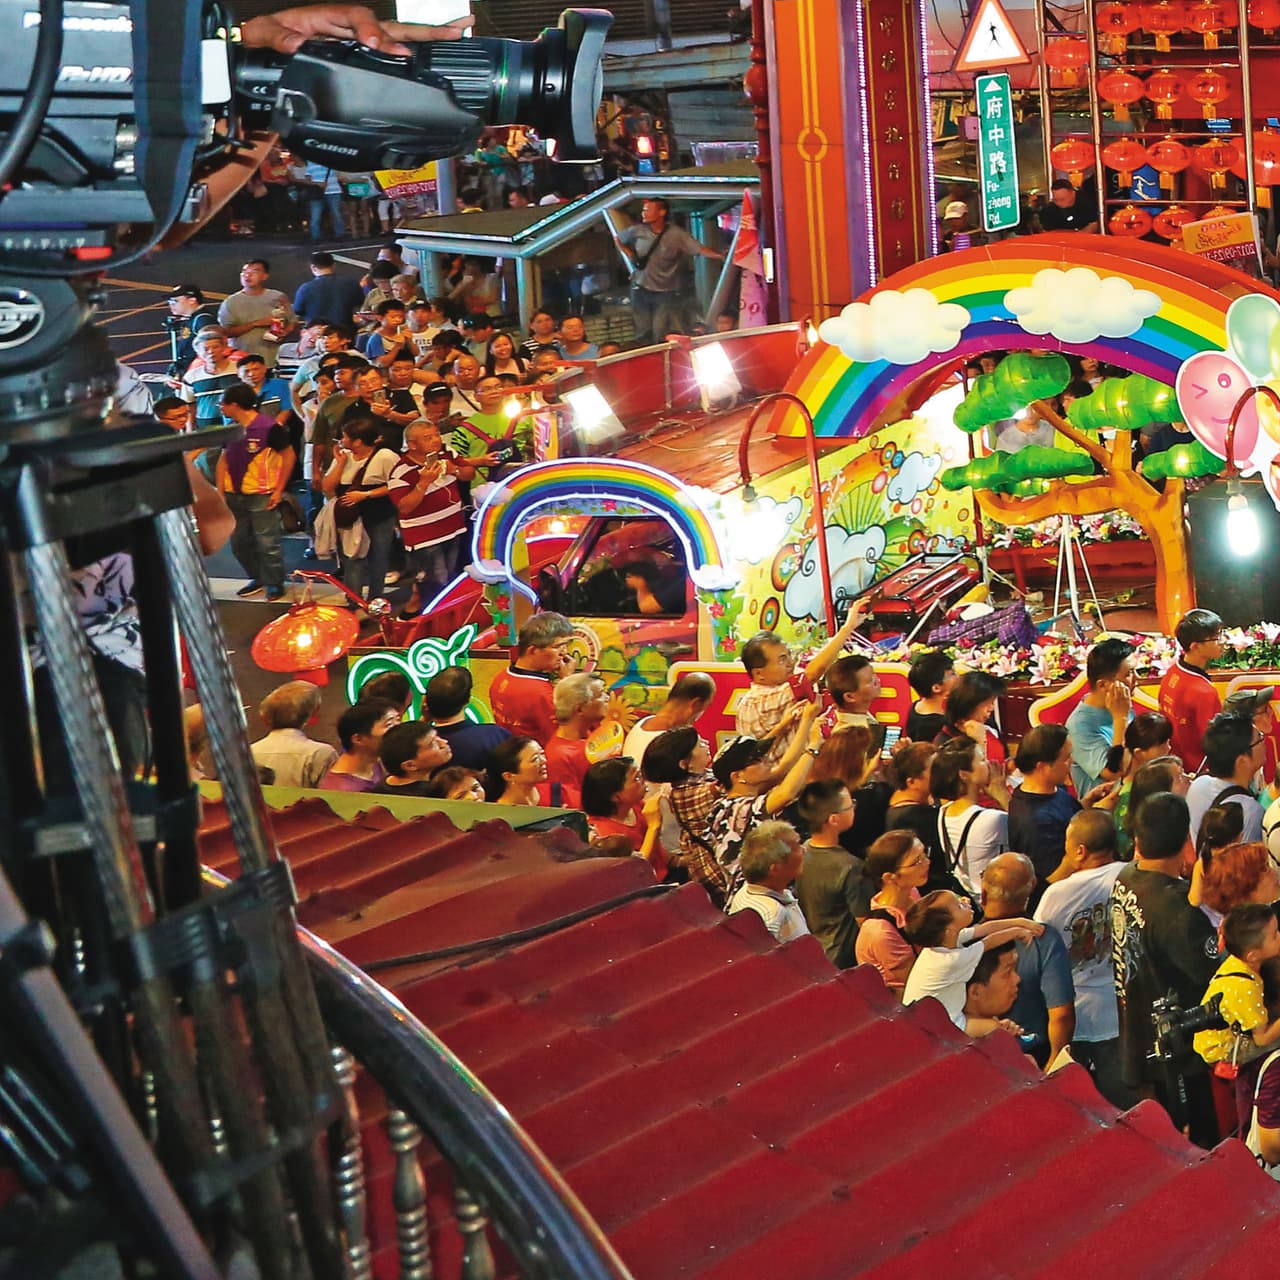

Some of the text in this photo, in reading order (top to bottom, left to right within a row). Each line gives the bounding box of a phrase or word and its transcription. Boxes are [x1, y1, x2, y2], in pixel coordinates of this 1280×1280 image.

[985, 95, 1008, 177] 府中路
[303, 137, 359, 157] Canon
[988, 195, 1012, 210] zhong
